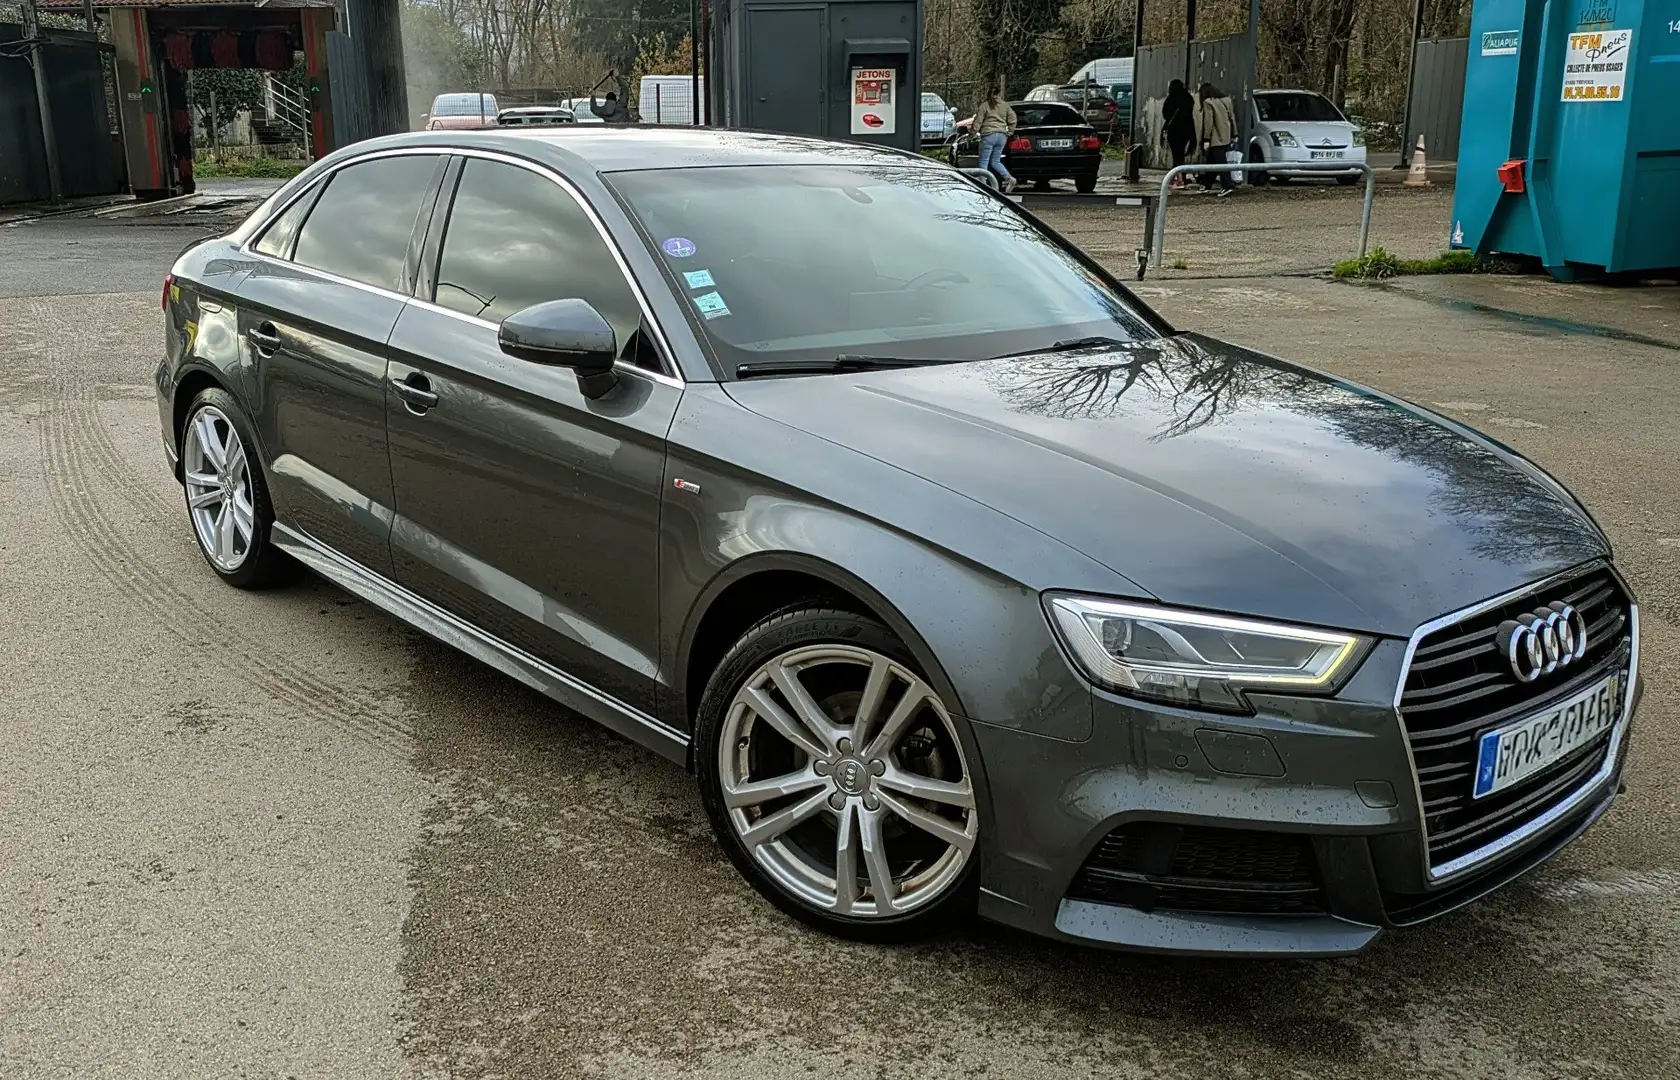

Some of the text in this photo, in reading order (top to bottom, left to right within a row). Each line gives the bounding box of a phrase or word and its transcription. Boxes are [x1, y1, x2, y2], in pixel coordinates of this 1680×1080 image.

[1570, 33, 1627, 62] TFM Pneus
[1585, 64, 1591, 73] DE
[1591, 63, 1605, 72] PNEUS
[856, 70, 891, 78] JETONS
